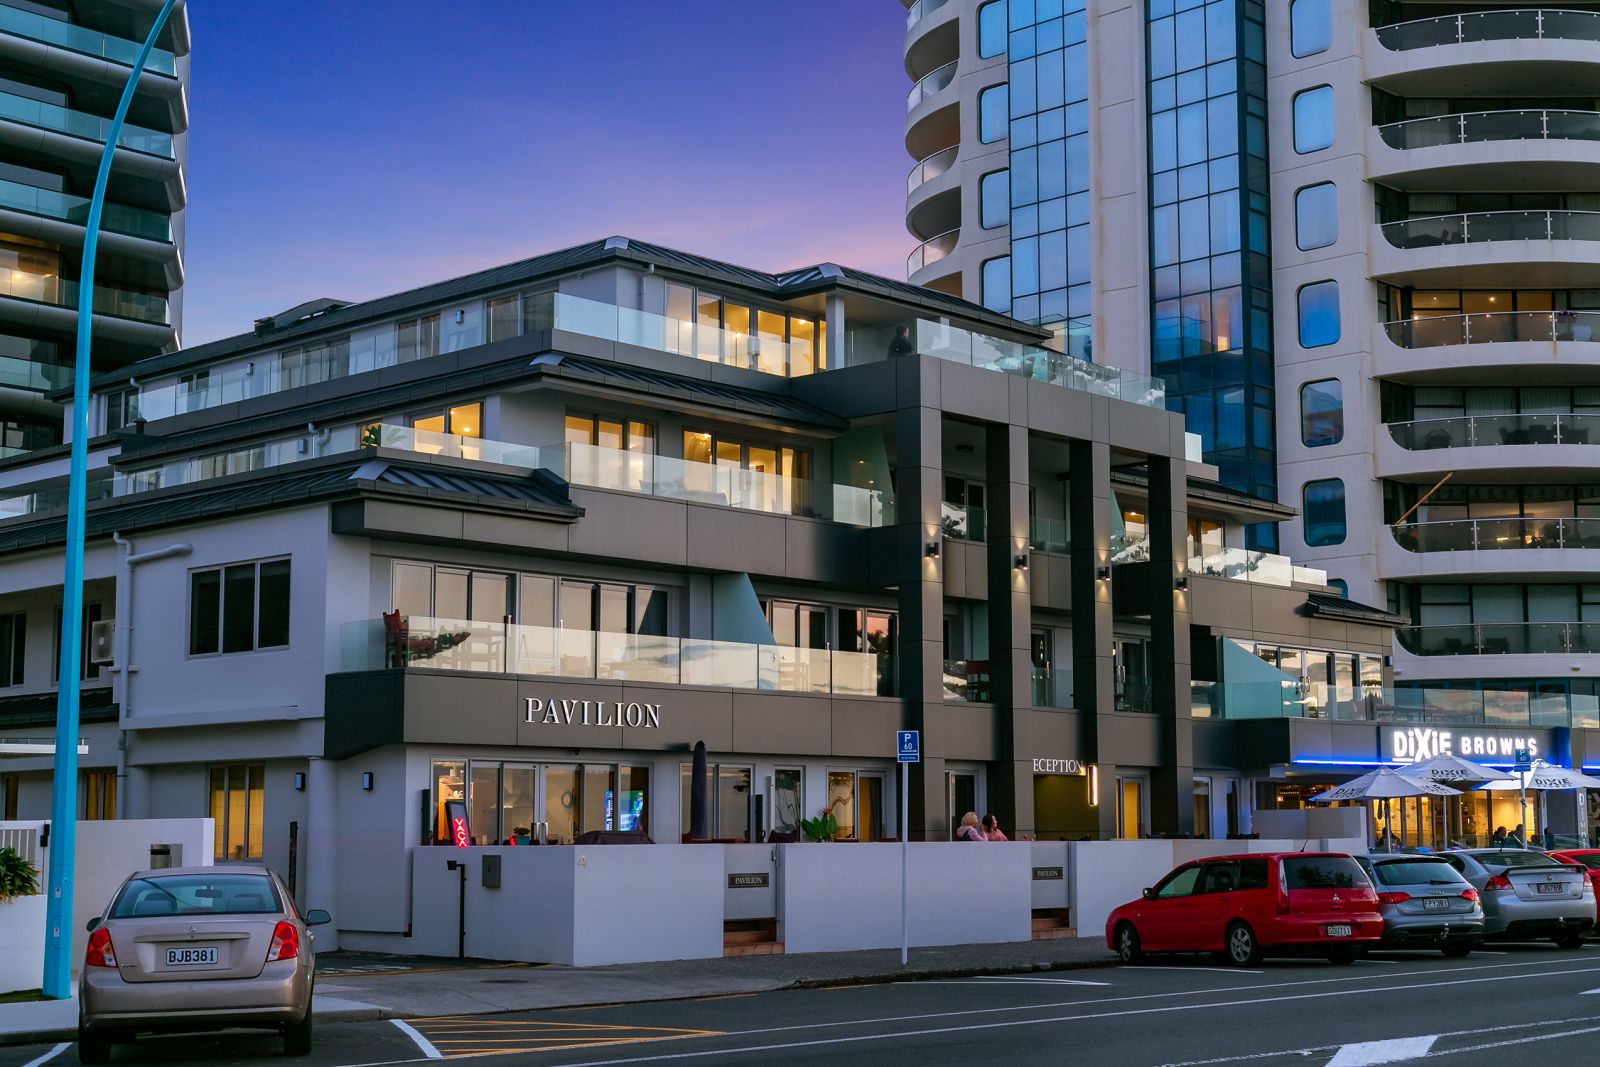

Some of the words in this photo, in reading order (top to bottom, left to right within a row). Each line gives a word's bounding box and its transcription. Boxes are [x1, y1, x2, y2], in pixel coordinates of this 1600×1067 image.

[524, 697, 661, 728] PAVILION
[904, 733, 912, 743] P
[904, 742, 913, 750] 60
[1461, 736, 1538, 756] BROWNS
[1033, 758, 1086, 775] ECEPTION
[455, 818, 468, 847] VACA
[735, 876, 763, 885] PAVILION
